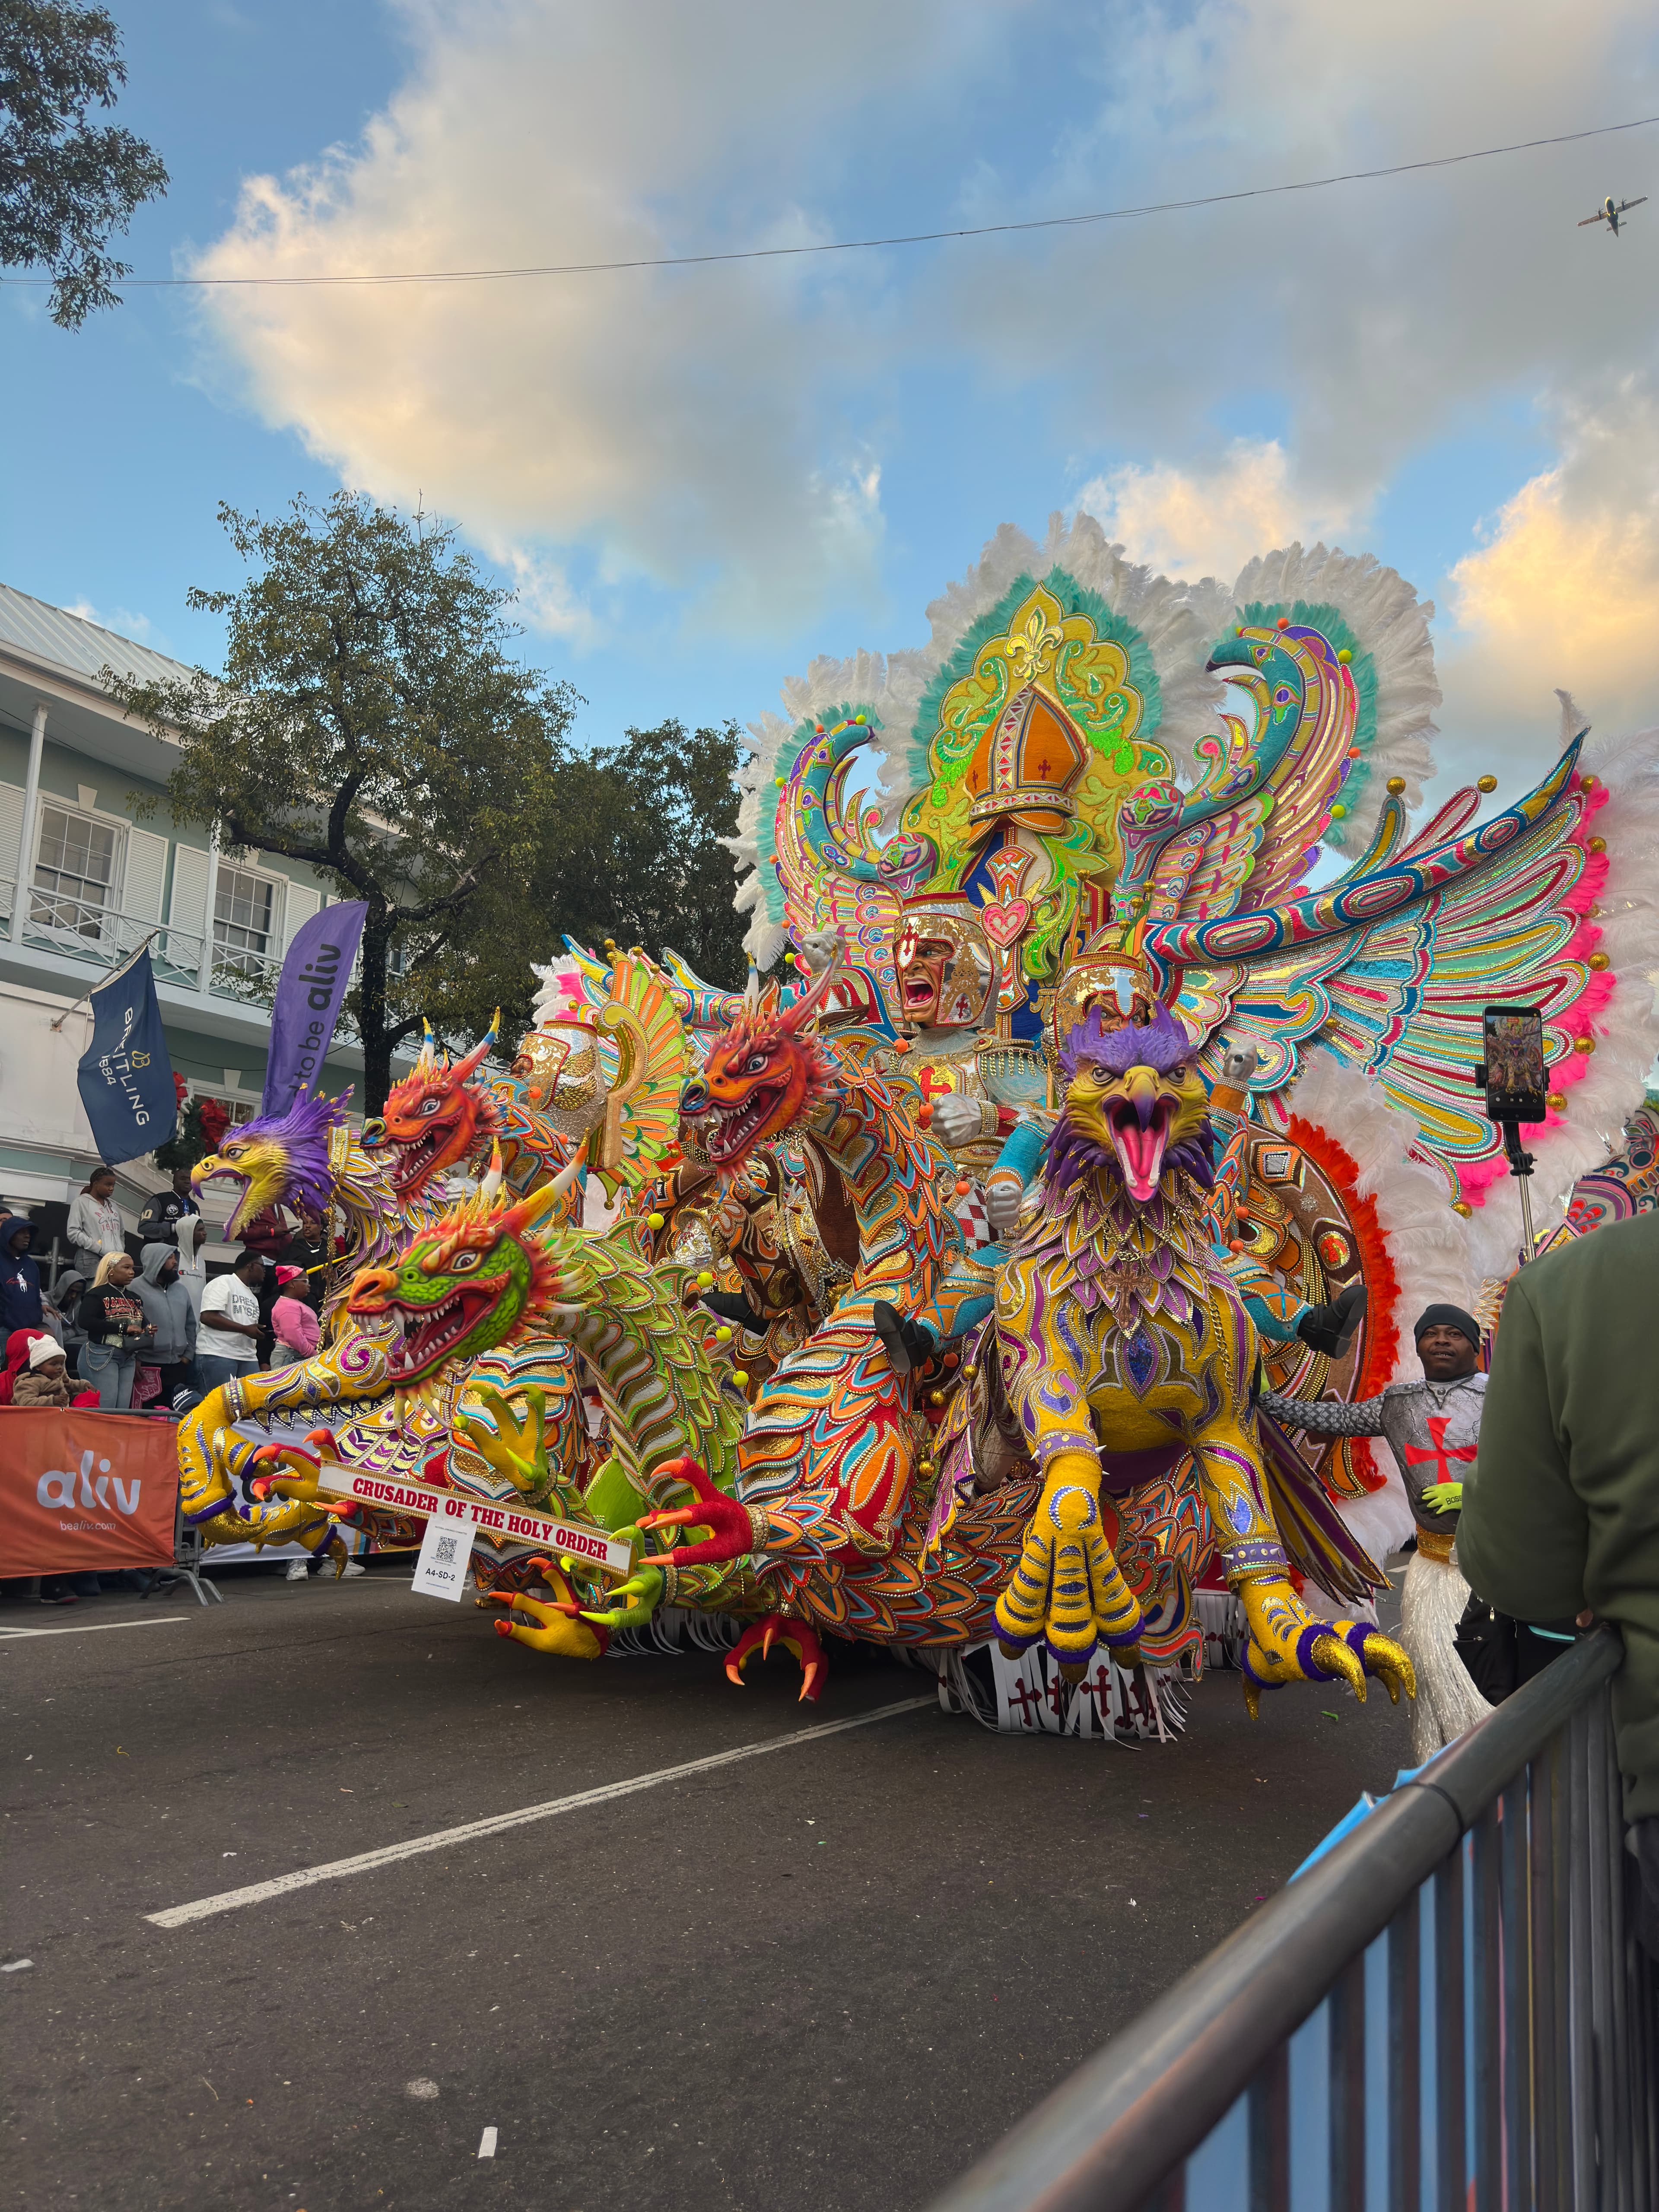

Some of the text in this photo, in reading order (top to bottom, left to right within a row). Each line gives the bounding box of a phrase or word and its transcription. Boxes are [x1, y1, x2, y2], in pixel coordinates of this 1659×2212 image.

[294, 944, 341, 1080] to be aliv
[99, 1055, 116, 1085] 1884
[173, 1389, 189, 1402] NIKE
[36, 1449, 141, 1515] aliv
[60, 1520, 117, 1531] bealiv.com
[353, 1478, 608, 1560] CRUSADER OF THE HOLY ORDER
[426, 1568, 455, 1581] A4-SD-2
